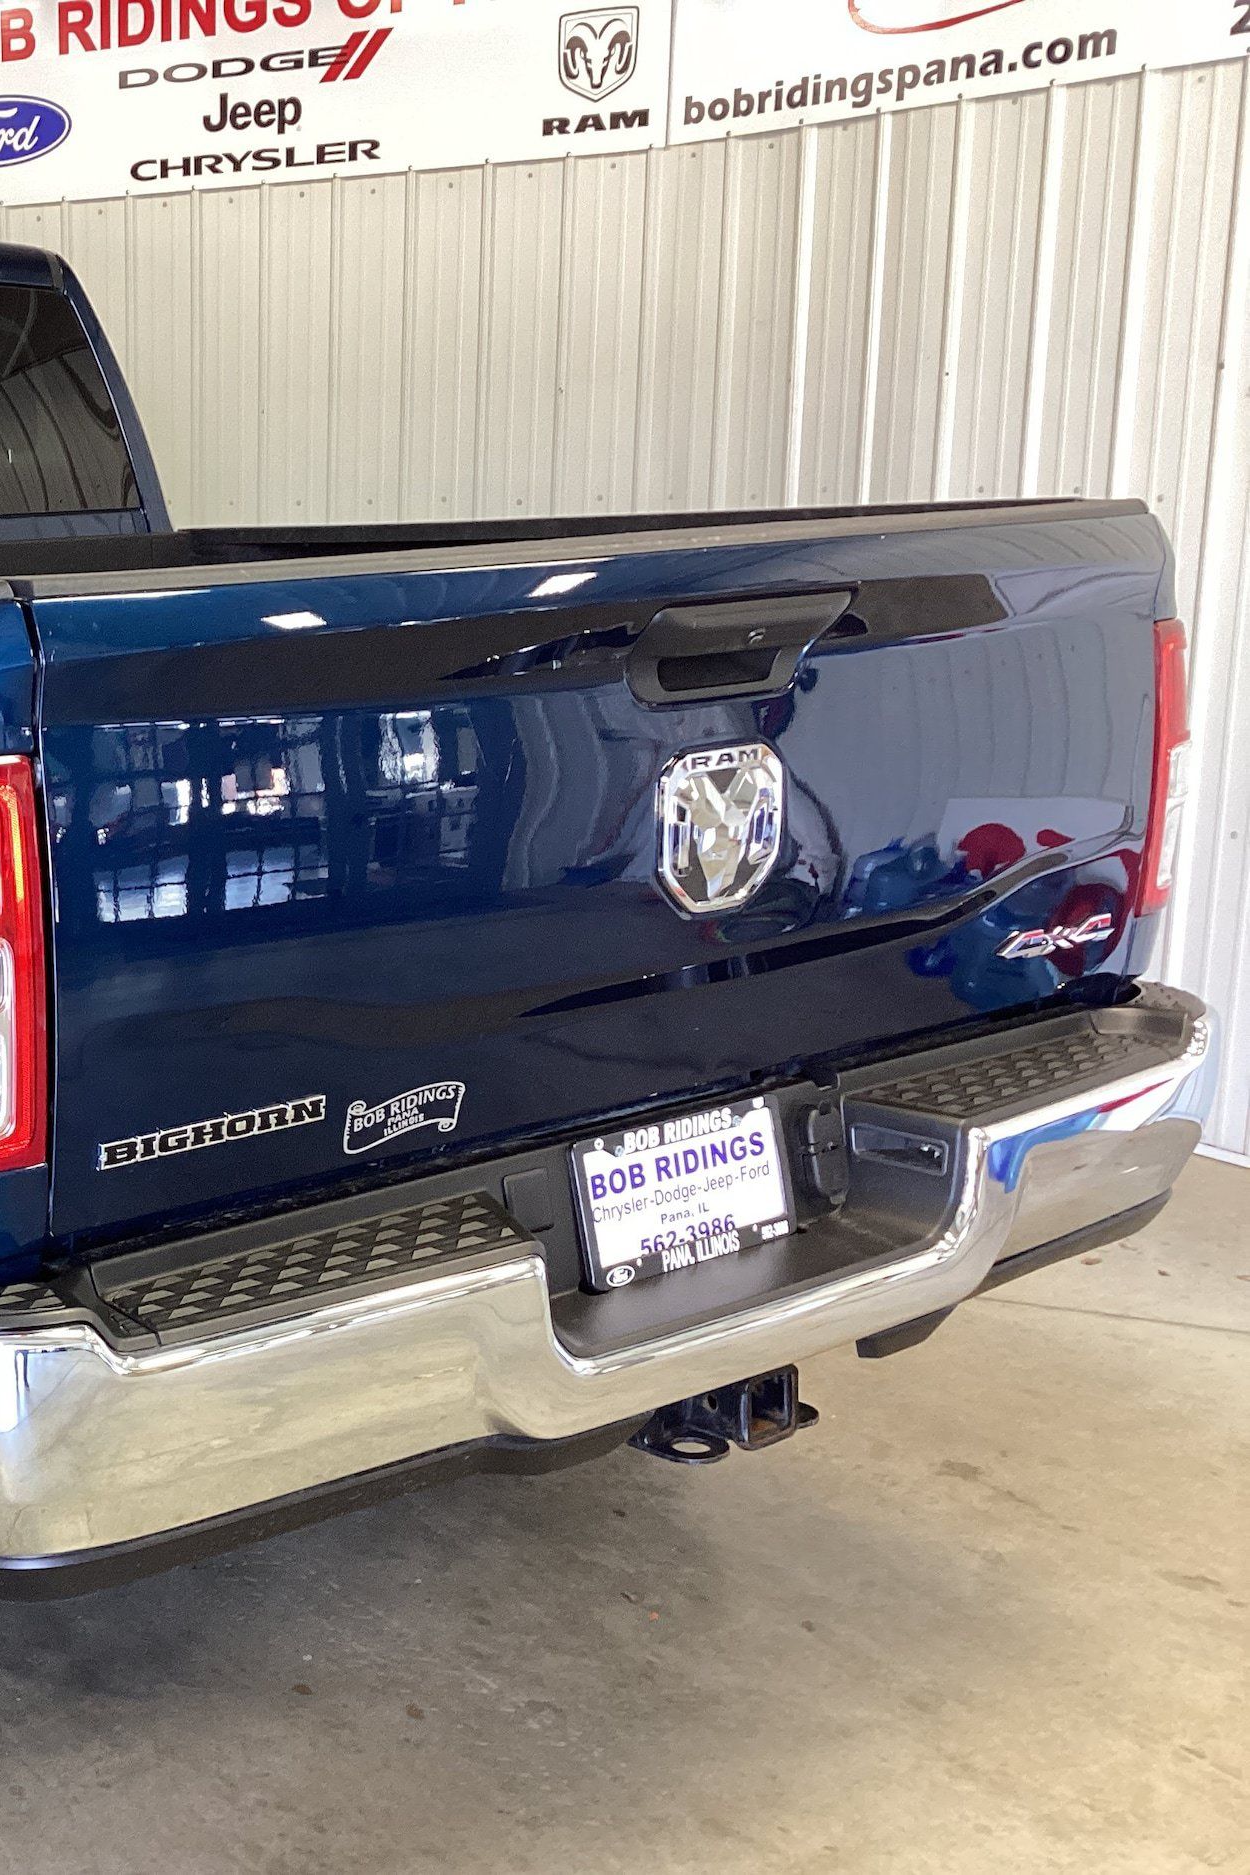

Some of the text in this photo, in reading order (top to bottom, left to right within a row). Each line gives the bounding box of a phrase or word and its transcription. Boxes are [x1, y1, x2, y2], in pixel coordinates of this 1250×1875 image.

[58, 0, 311, 55] RIDINGS
[119, 44, 350, 89] DODGE
[683, 27, 1118, 126] bobridingspana.com
[202, 92, 302, 134] Jeep
[542, 108, 650, 136] RAM
[130, 138, 381, 182] CHRYSLER
[691, 748, 761, 770] RAM
[353, 1085, 456, 1133] BOB RIDINGS
[384, 1113, 425, 1137] ILLINOIS
[387, 1107, 419, 1126] PANA
[623, 1108, 732, 1153] BOB RIDINGS
[97, 1095, 327, 1171] BIGHORN
[591, 1131, 765, 1200] BOB RIDINGS
[698, 1202, 710, 1214] IL
[695, 1229, 740, 1263] ILLINOIS
